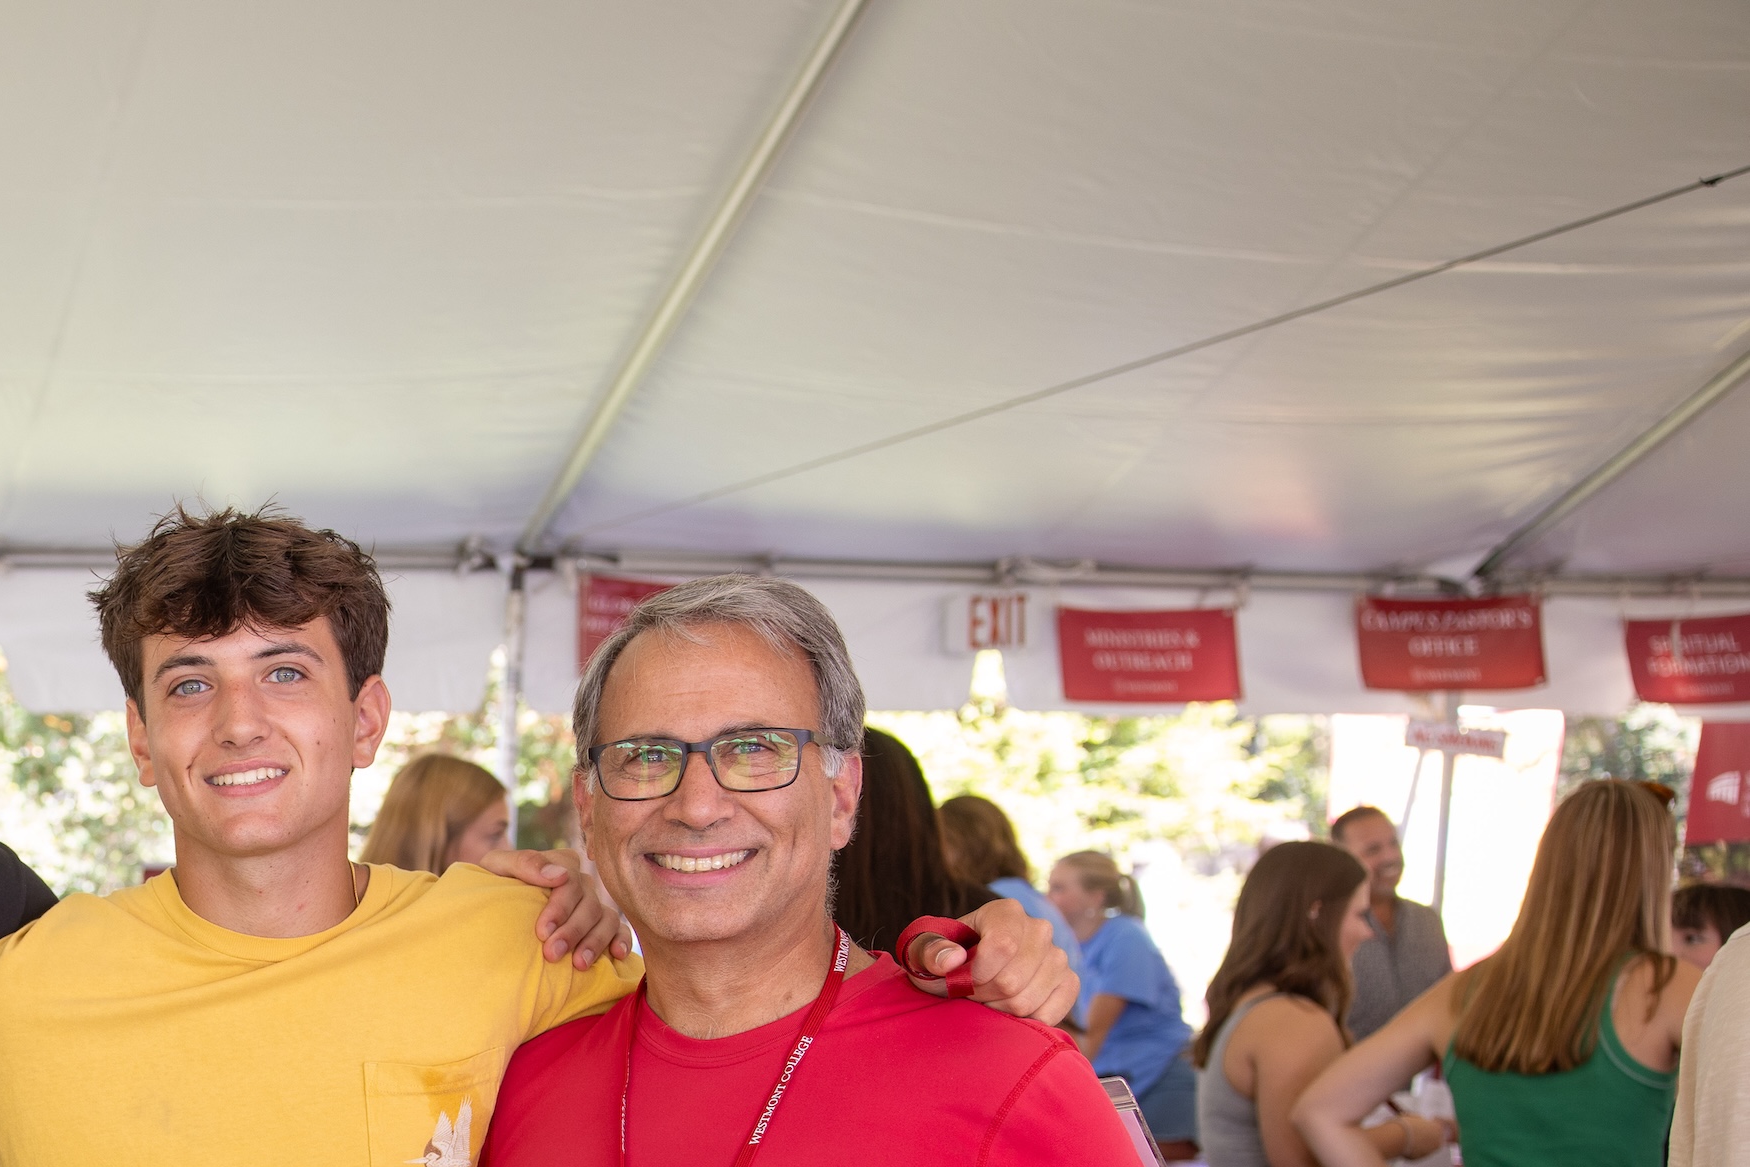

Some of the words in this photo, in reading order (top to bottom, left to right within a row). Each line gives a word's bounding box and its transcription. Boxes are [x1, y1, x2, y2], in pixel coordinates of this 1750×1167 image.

[968, 595, 1026, 648] EXIT
[749, 1078, 787, 1145] WESTMONT
[780, 1035, 813, 1083] COLLEGE
